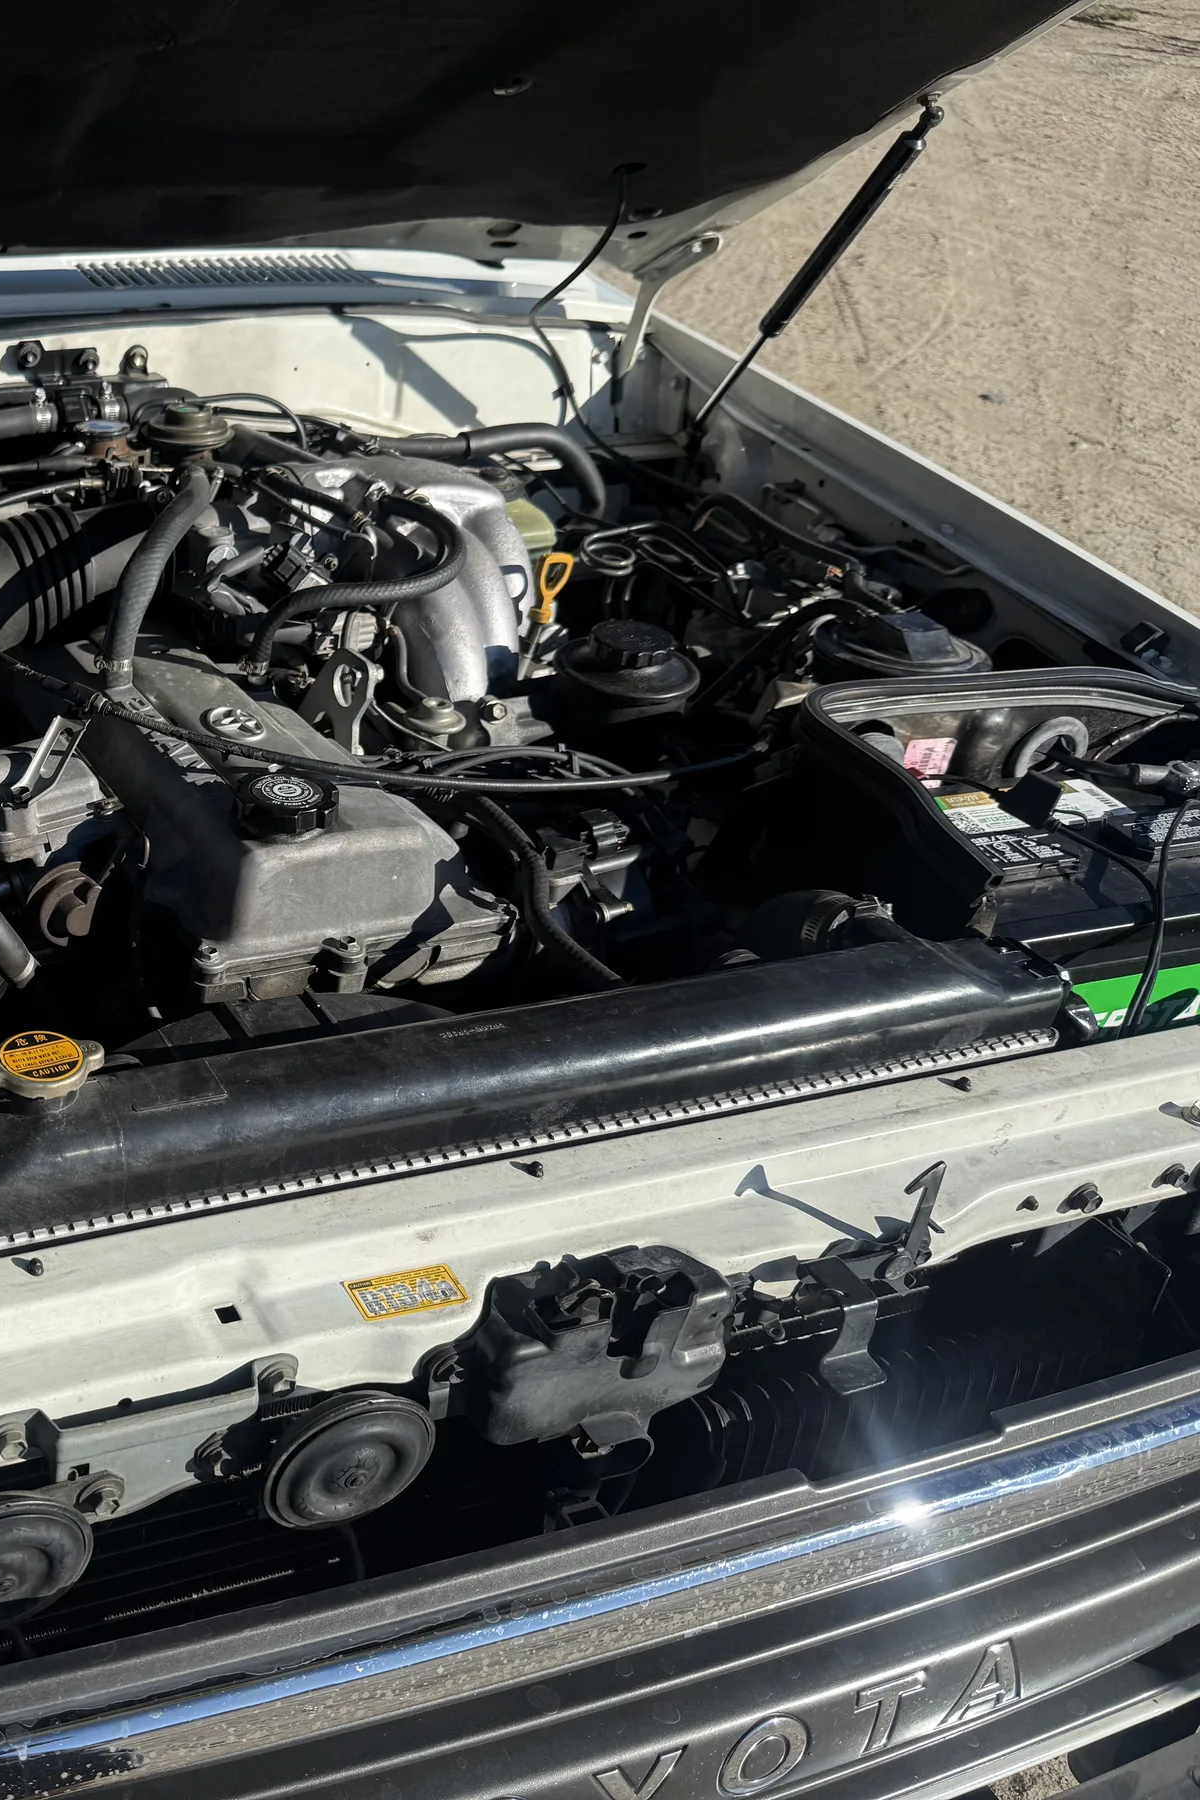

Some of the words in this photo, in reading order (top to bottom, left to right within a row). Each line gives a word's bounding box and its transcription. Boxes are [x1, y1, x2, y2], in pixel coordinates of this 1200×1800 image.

[32, 1063, 71, 1077] CAUTION
[349, 1280, 372, 1290] CAUTION
[493, 1638, 1024, 1800] YOTA
